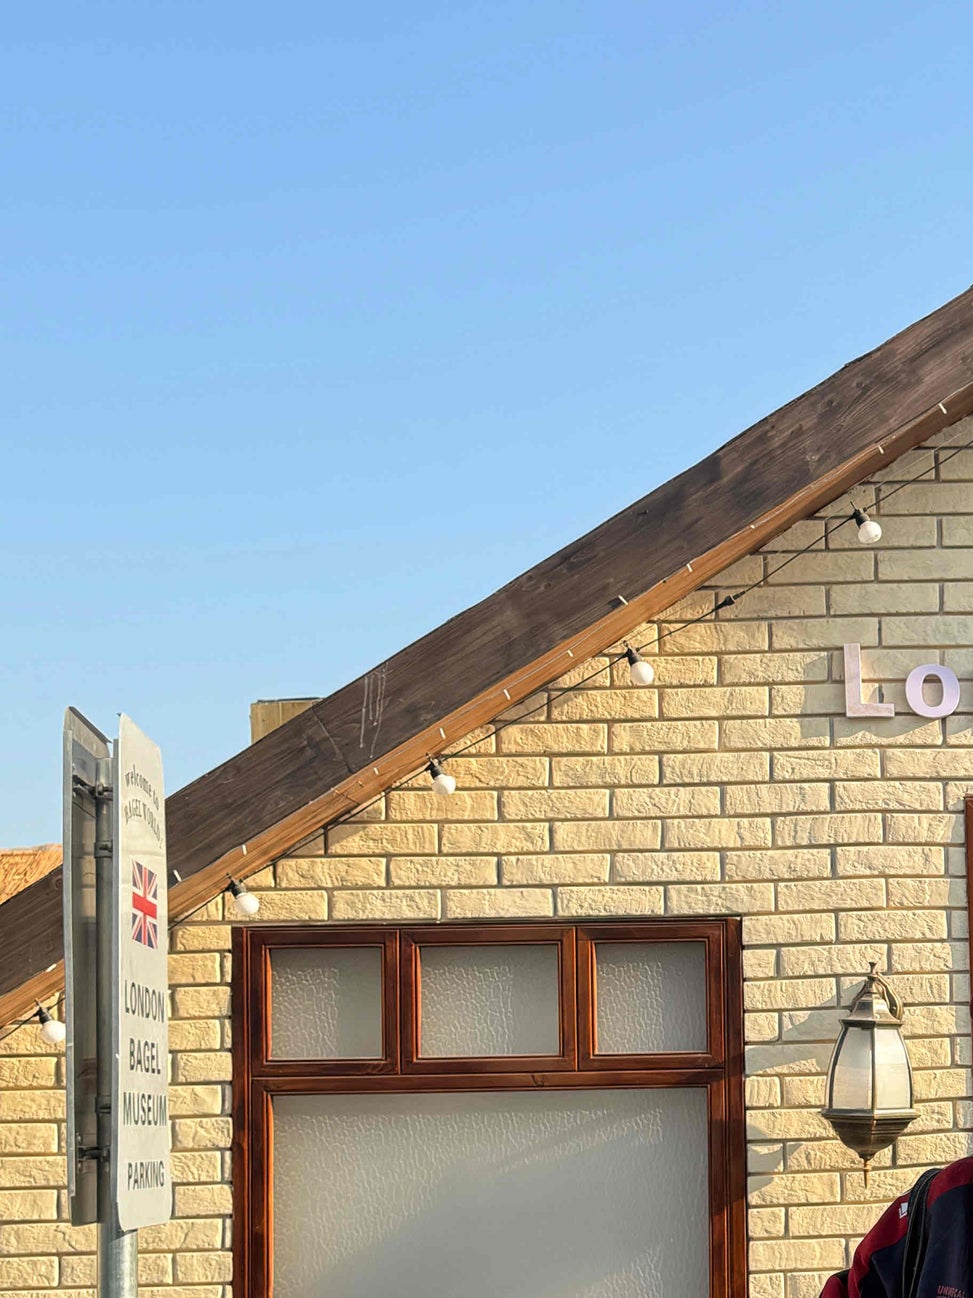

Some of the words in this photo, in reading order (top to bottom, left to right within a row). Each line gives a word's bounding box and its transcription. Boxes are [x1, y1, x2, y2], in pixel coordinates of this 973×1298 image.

[125, 979, 165, 1023] LONDON
[129, 1037, 161, 1075] BAGEL
[123, 1091, 167, 1127] MUSEUM
[127, 1160, 165, 1191] PARKING
